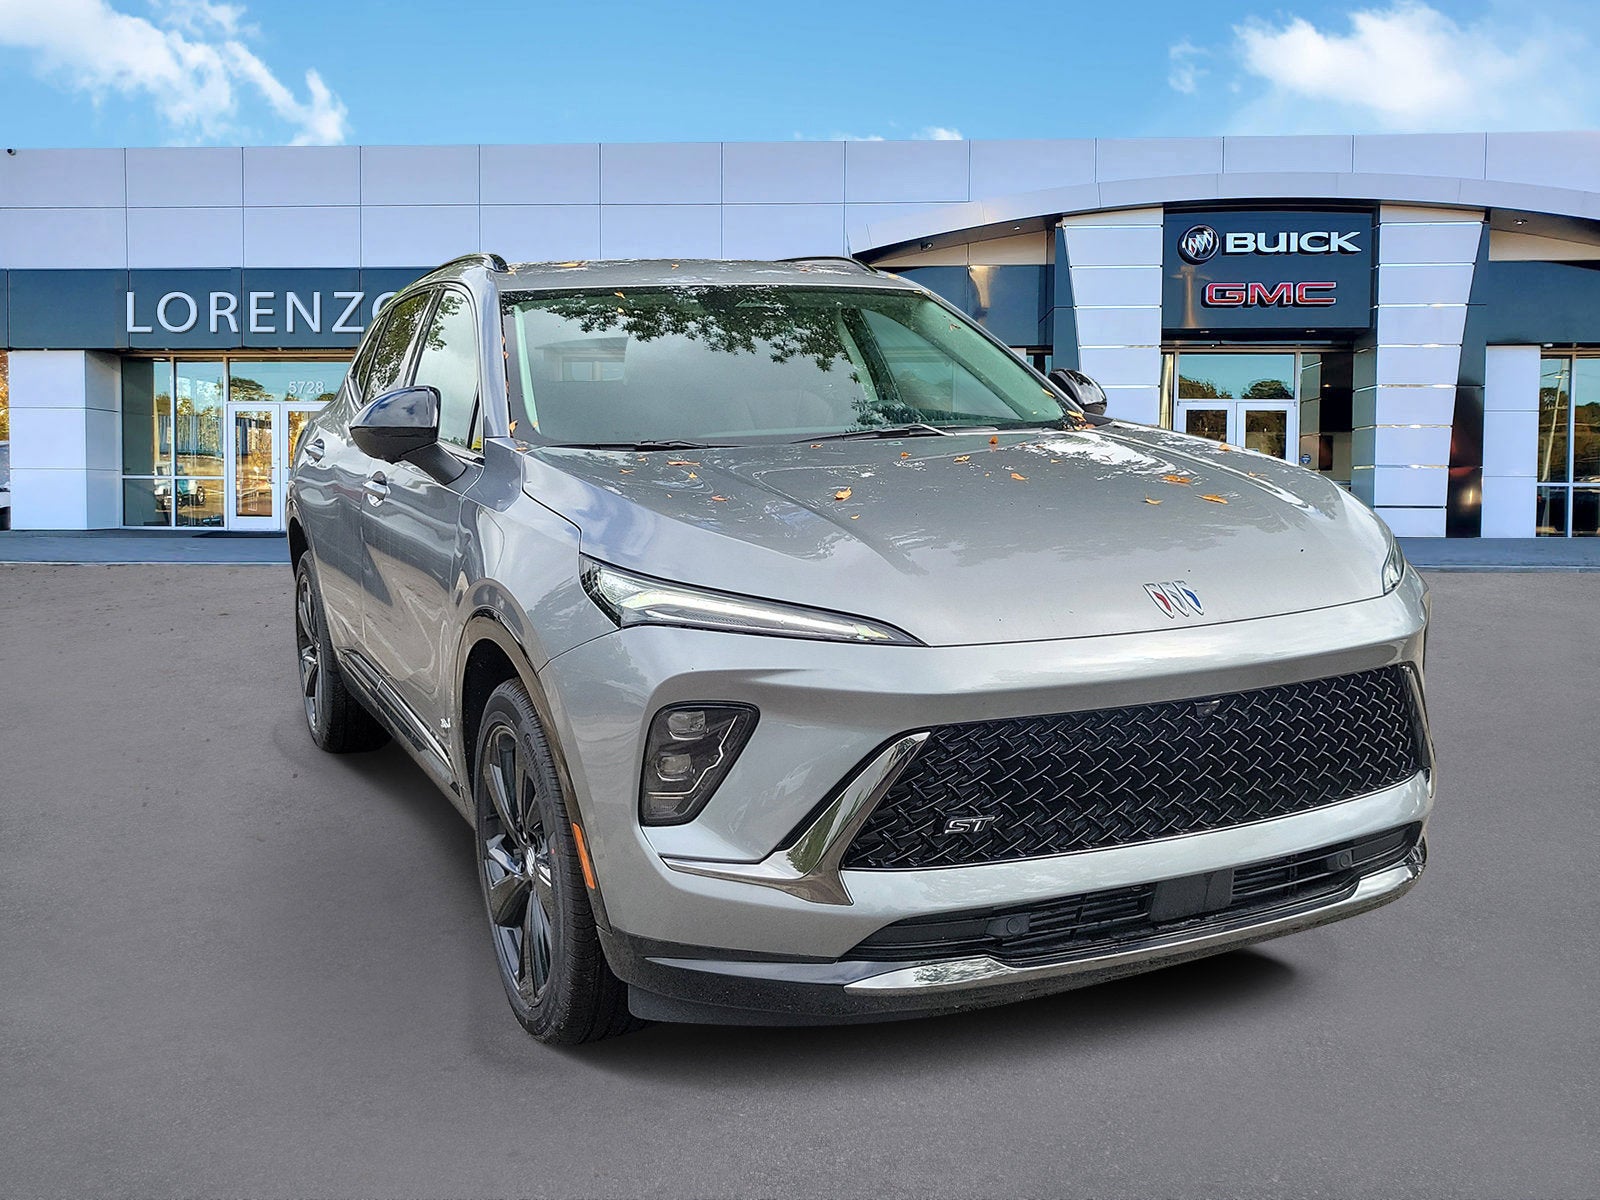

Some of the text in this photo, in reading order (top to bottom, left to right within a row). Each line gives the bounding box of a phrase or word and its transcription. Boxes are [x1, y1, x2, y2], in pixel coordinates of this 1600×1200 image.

[1225, 231, 1362, 253] BUICK
[1204, 281, 1337, 306] GMC
[288, 380, 325, 395] 5728
[943, 815, 996, 835] ST
